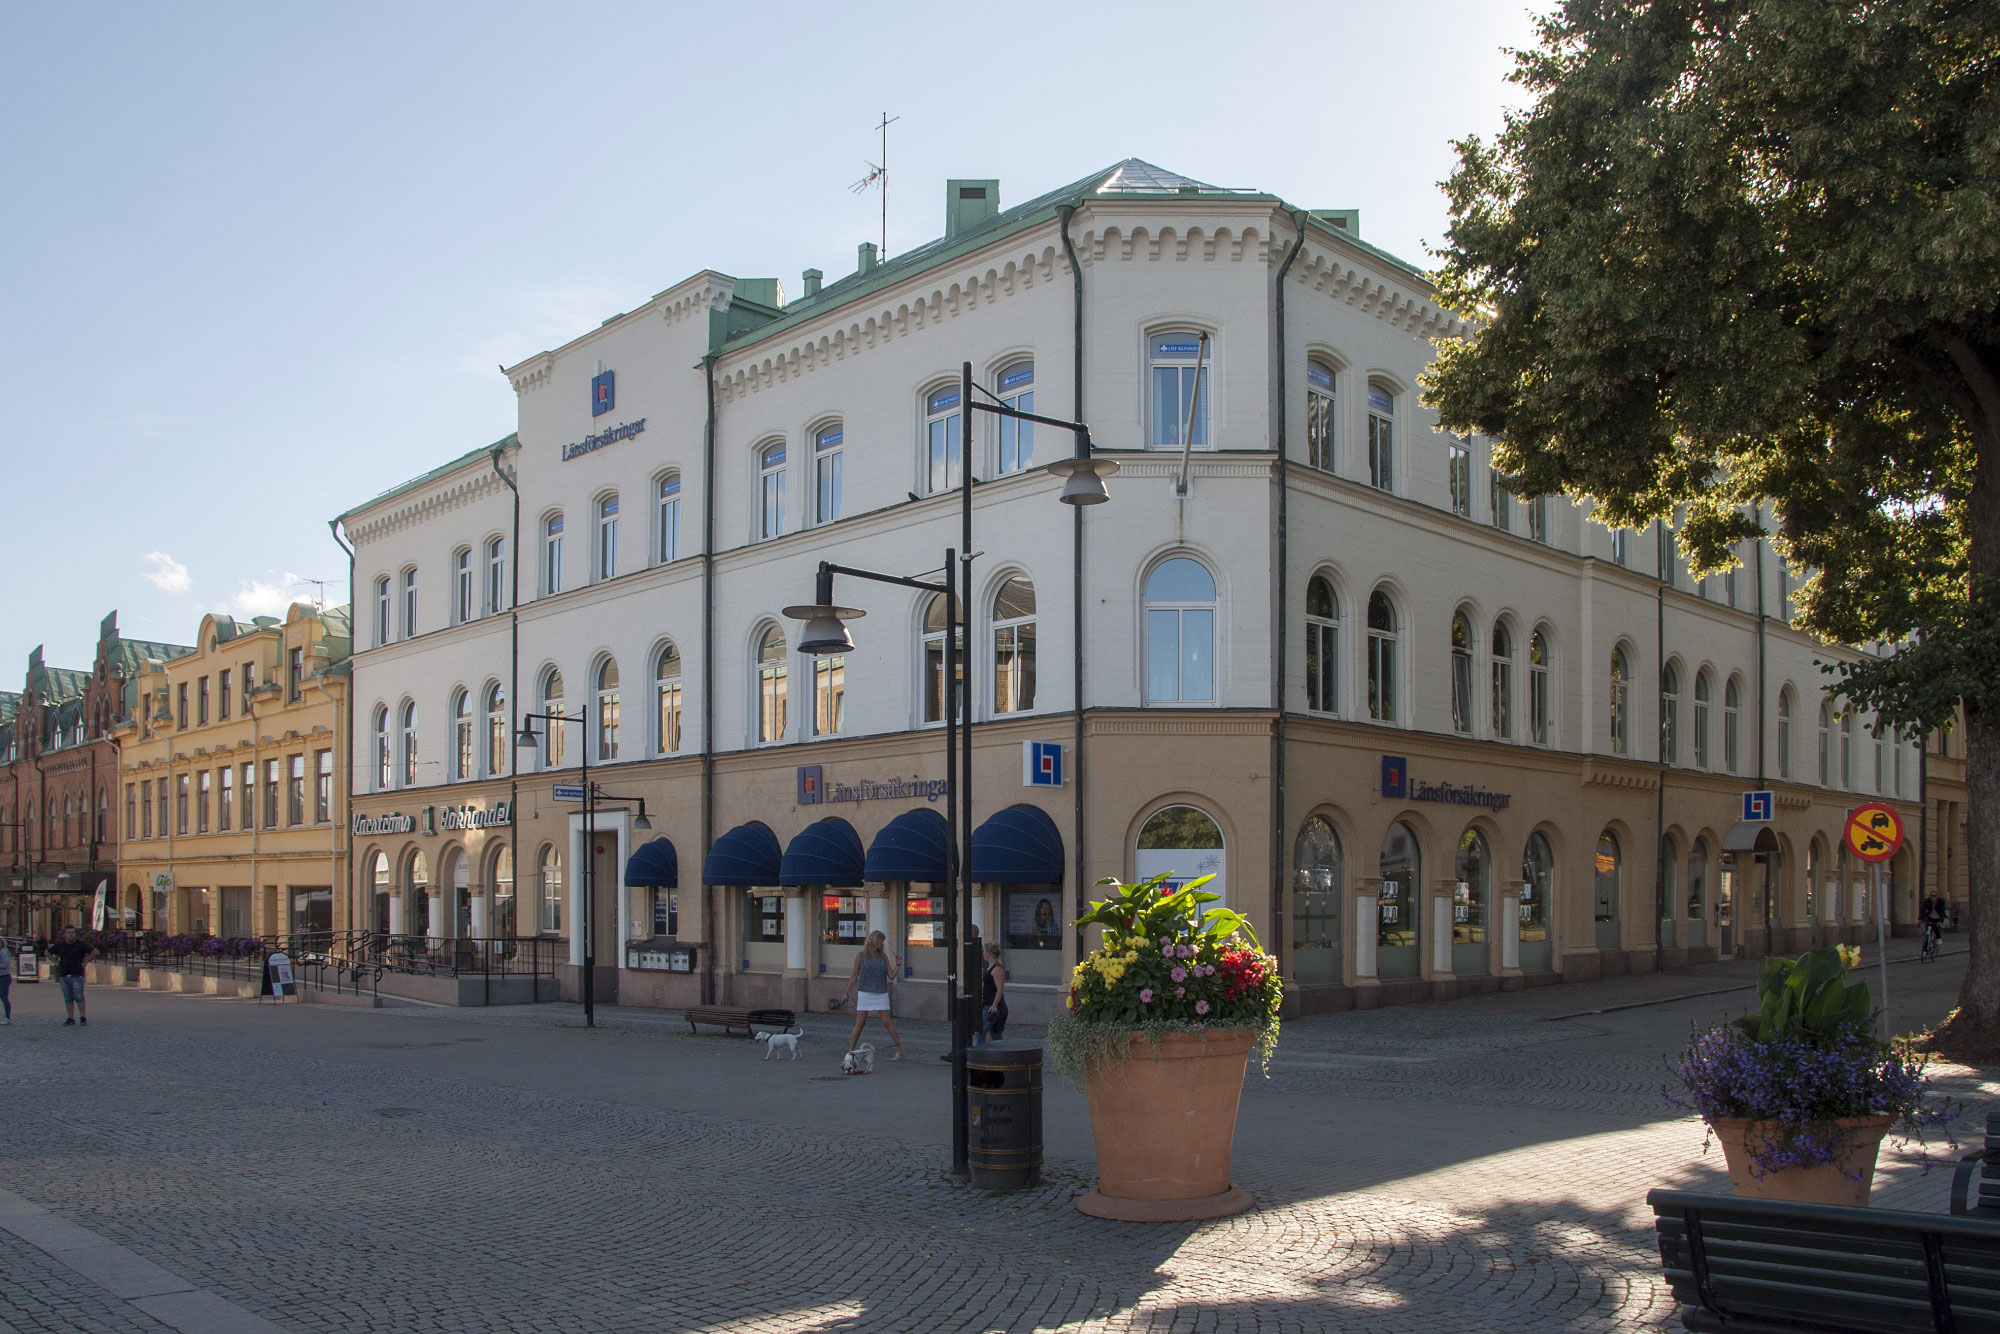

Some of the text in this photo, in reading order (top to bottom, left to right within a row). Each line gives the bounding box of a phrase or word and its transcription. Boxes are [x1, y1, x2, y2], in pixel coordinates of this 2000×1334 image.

[562, 417, 647, 462] Länsförsäkringar
[824, 775, 948, 802] Länsförsäkringa
[1409, 778, 1511, 813] Länsförsäkringar
[439, 800, 512, 831] Bokhandel
